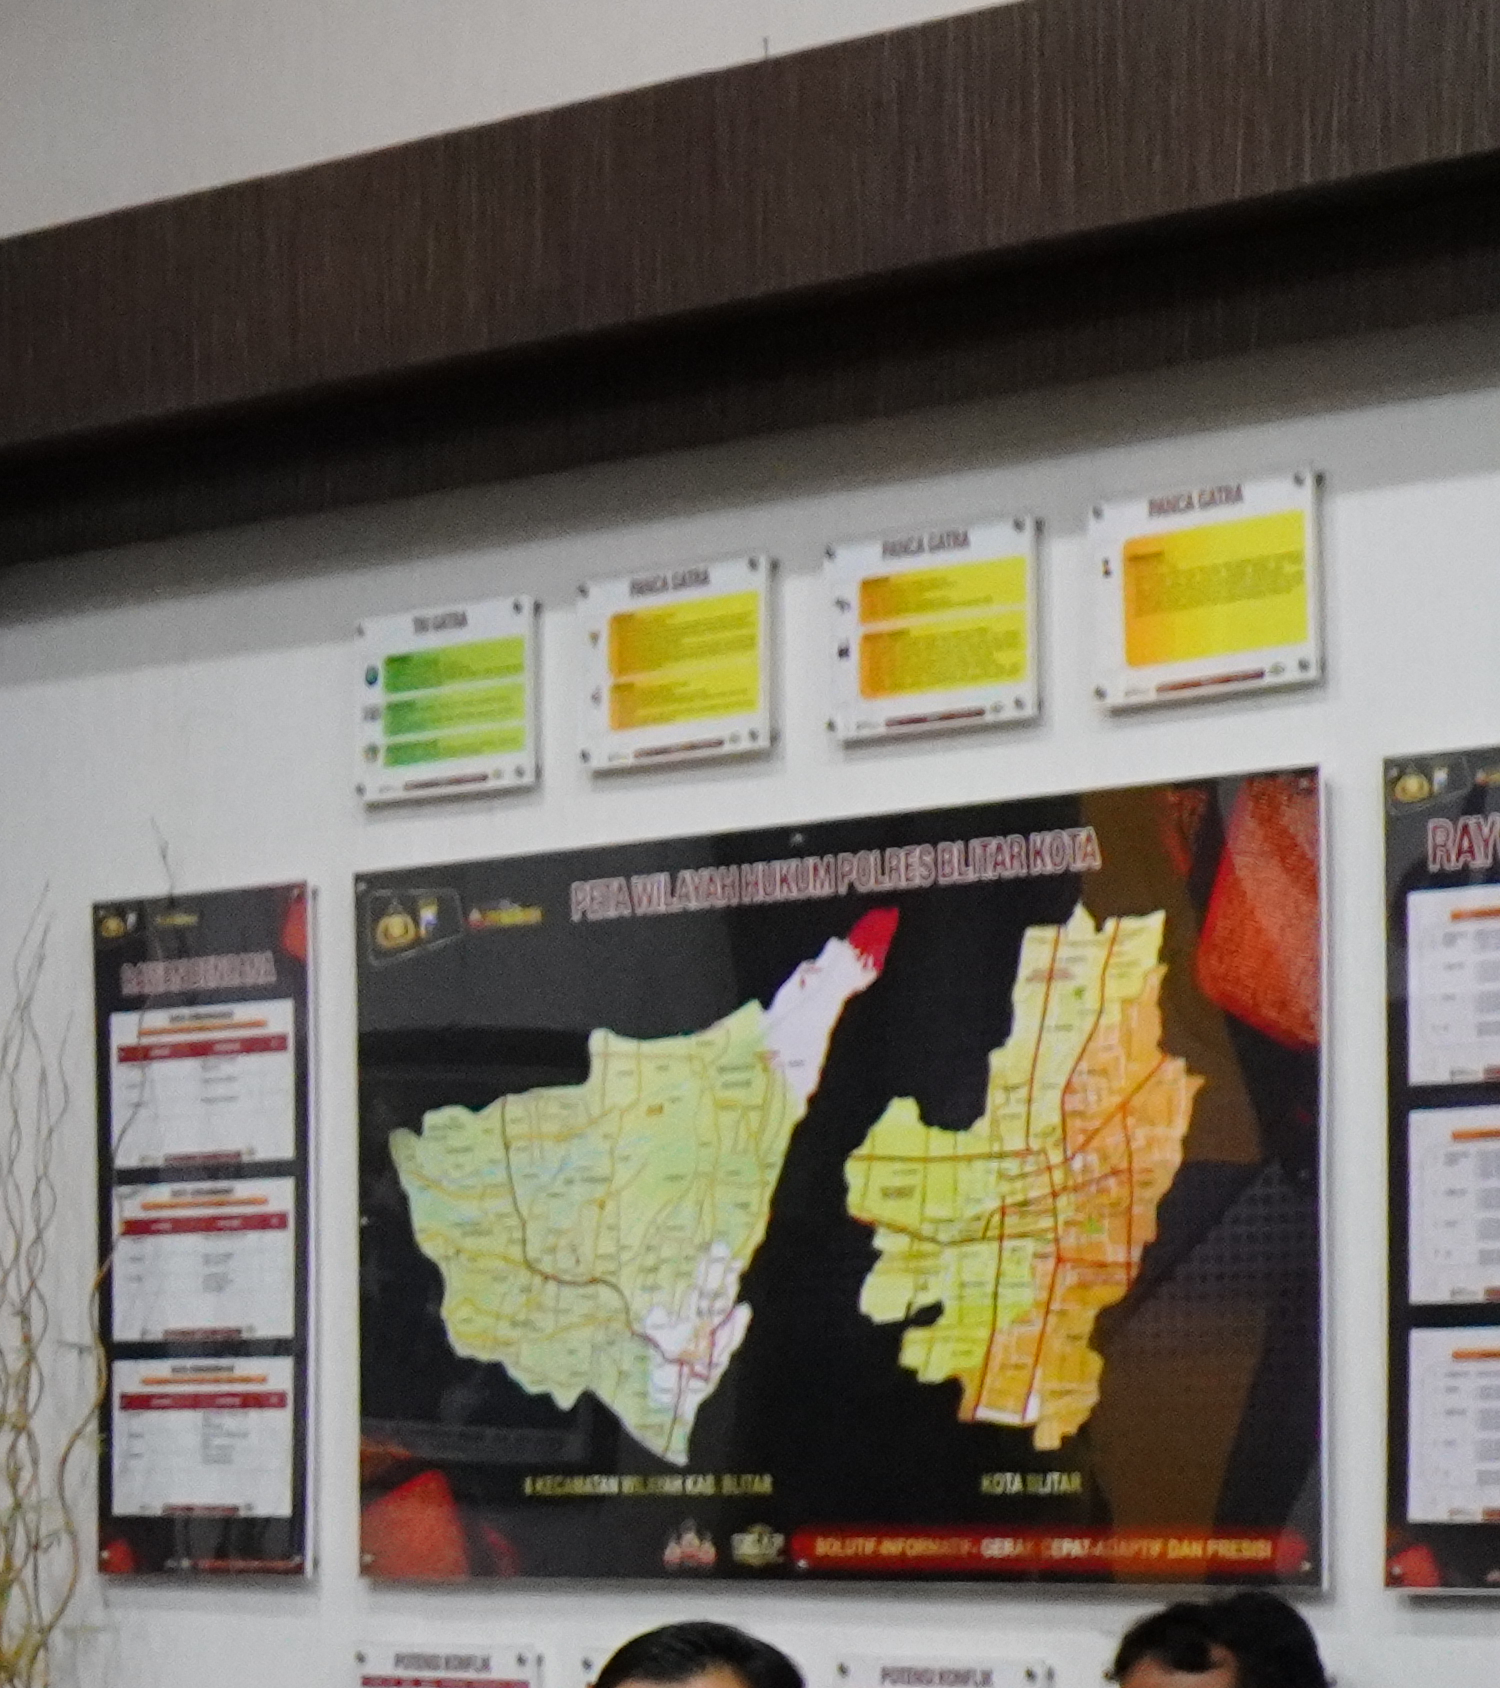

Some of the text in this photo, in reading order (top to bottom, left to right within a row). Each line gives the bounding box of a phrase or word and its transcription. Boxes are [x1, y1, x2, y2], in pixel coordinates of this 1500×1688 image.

[1427, 812, 1500, 873] RAY
[571, 877, 632, 922] PETA
[631, 864, 741, 915] WILAYAH
[740, 852, 836, 905] HUKUM
[836, 843, 936, 896] POLRES
[936, 833, 1028, 886] BLITAR
[1028, 826, 1102, 876] KOTA
[982, 1471, 1025, 1494] KOTA
[880, 1665, 934, 1687] POTENSI
